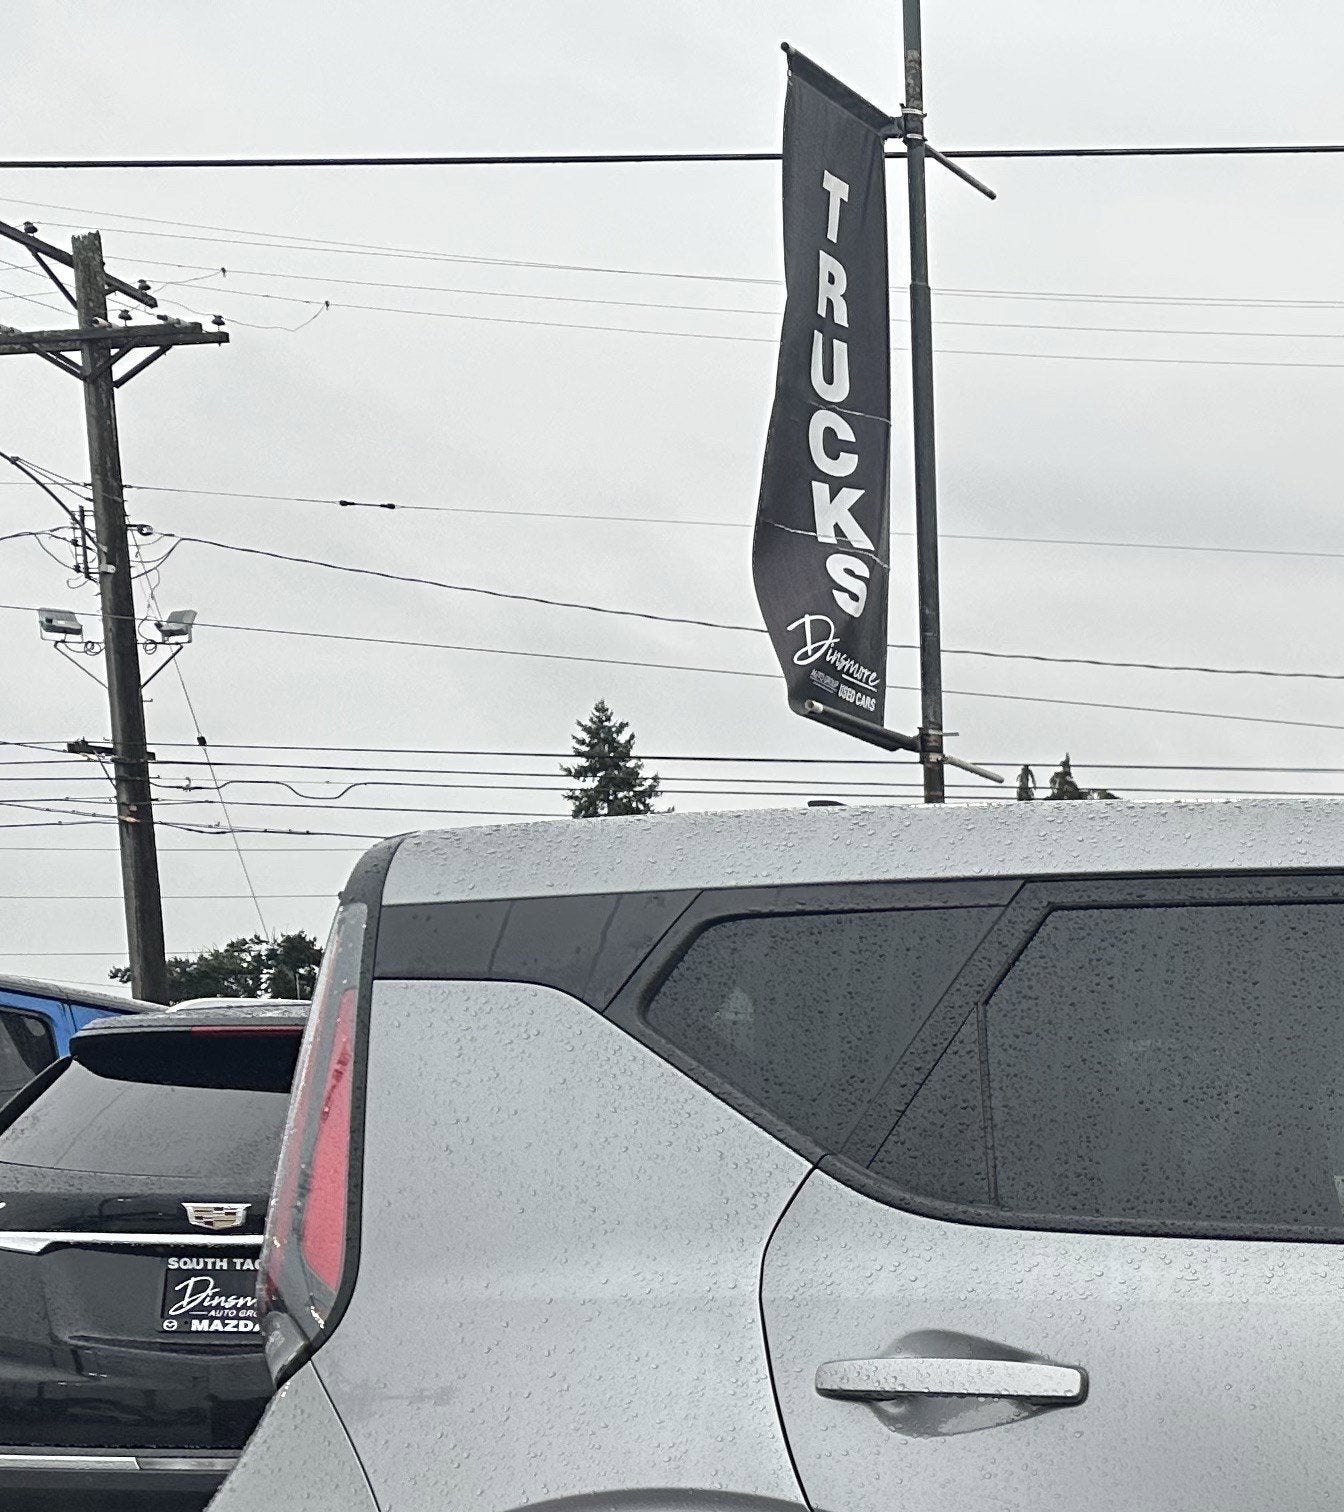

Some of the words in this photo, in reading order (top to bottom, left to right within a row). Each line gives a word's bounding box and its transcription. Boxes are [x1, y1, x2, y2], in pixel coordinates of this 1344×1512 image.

[807, 169, 873, 618] TRUCKS
[787, 613, 880, 687] Dinsmore
[856, 692, 876, 711] CARS
[168, 1257, 228, 1270] SOUTH
[208, 1309, 237, 1317] AUTO
